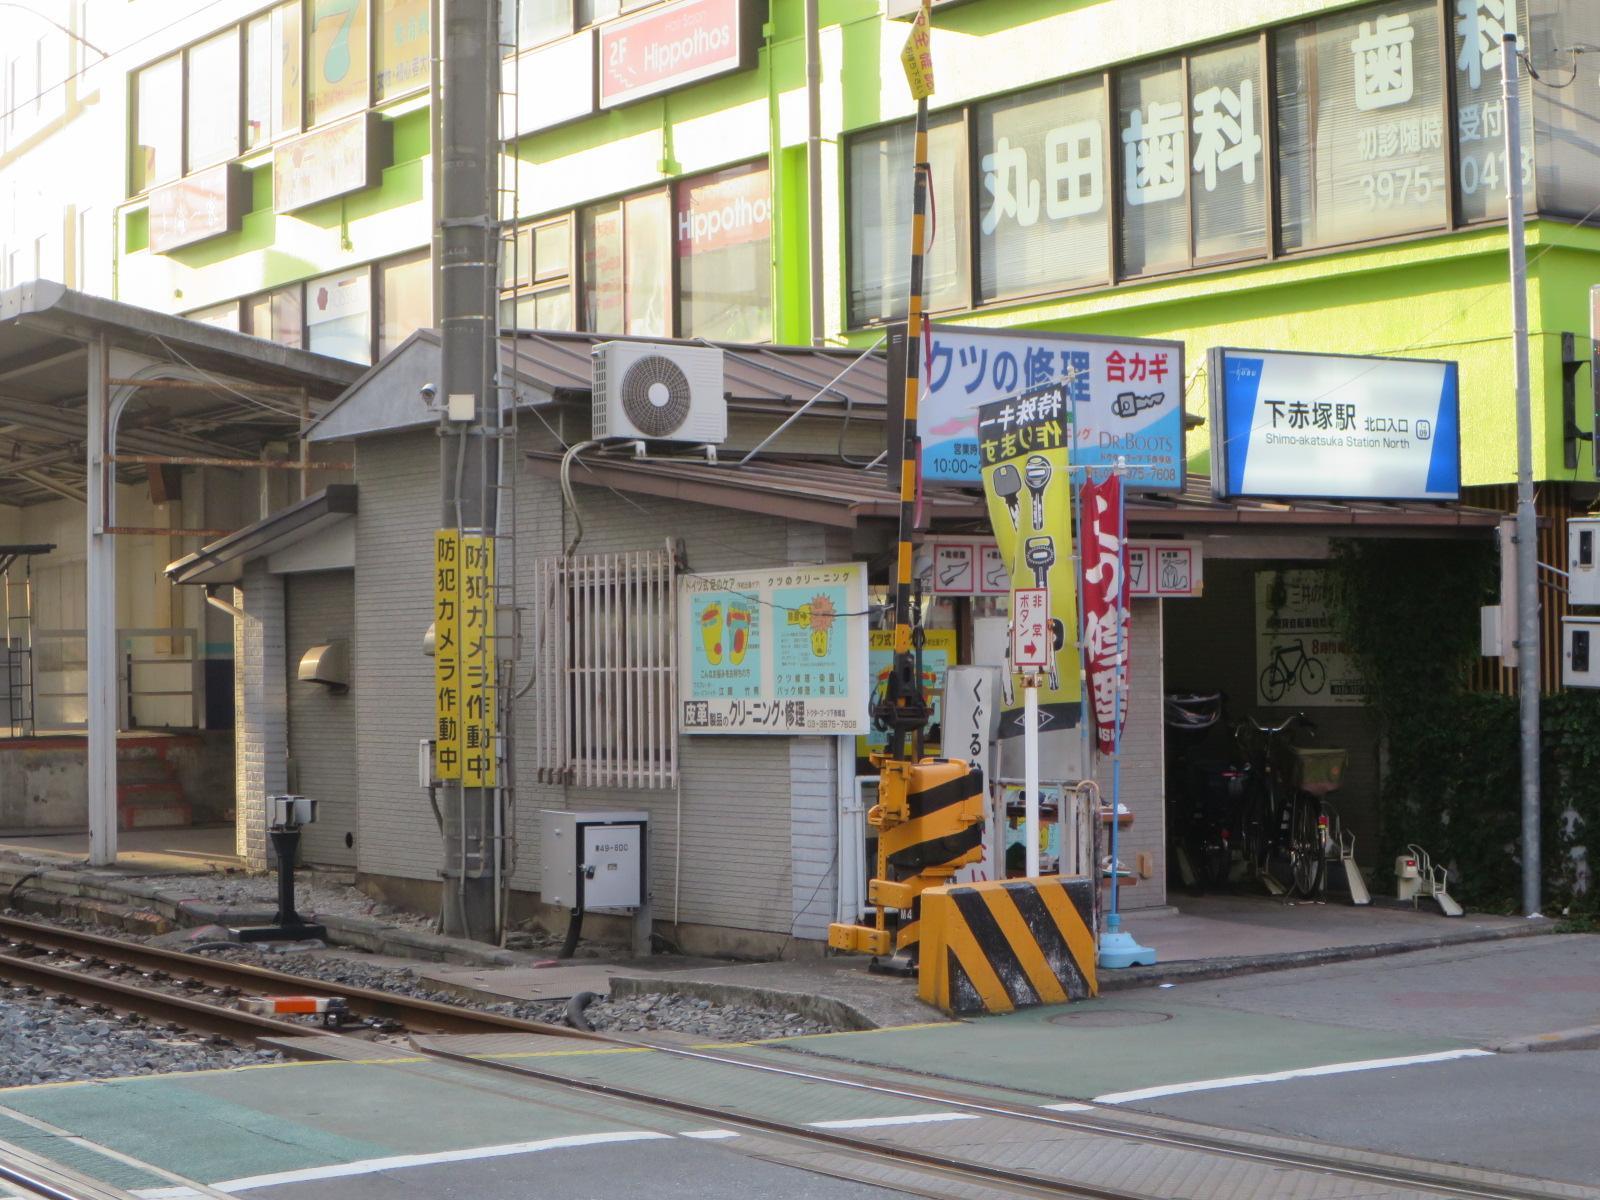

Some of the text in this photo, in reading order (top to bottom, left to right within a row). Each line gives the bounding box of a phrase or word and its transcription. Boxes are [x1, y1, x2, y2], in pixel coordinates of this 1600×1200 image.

[609, 24, 730, 73] 2F Hippothos
[981, 78, 1262, 236] 丸田歯科
[925, 341, 1091, 402] クツの修理
[1105, 350, 1169, 384] 合カギ
[1264, 399, 1357, 431] 下赤塚駅
[1364, 416, 1409, 434] 北口入口
[1265, 432, 1410, 450] Shimo-akatsuka Station North
[768, 572, 850, 587] クツのクリーニング
[1019, 594, 1029, 637] ボタン
[437, 537, 457, 772] 防犯カメラ作動中
[464, 545, 491, 780] 防犯カメラ作動中
